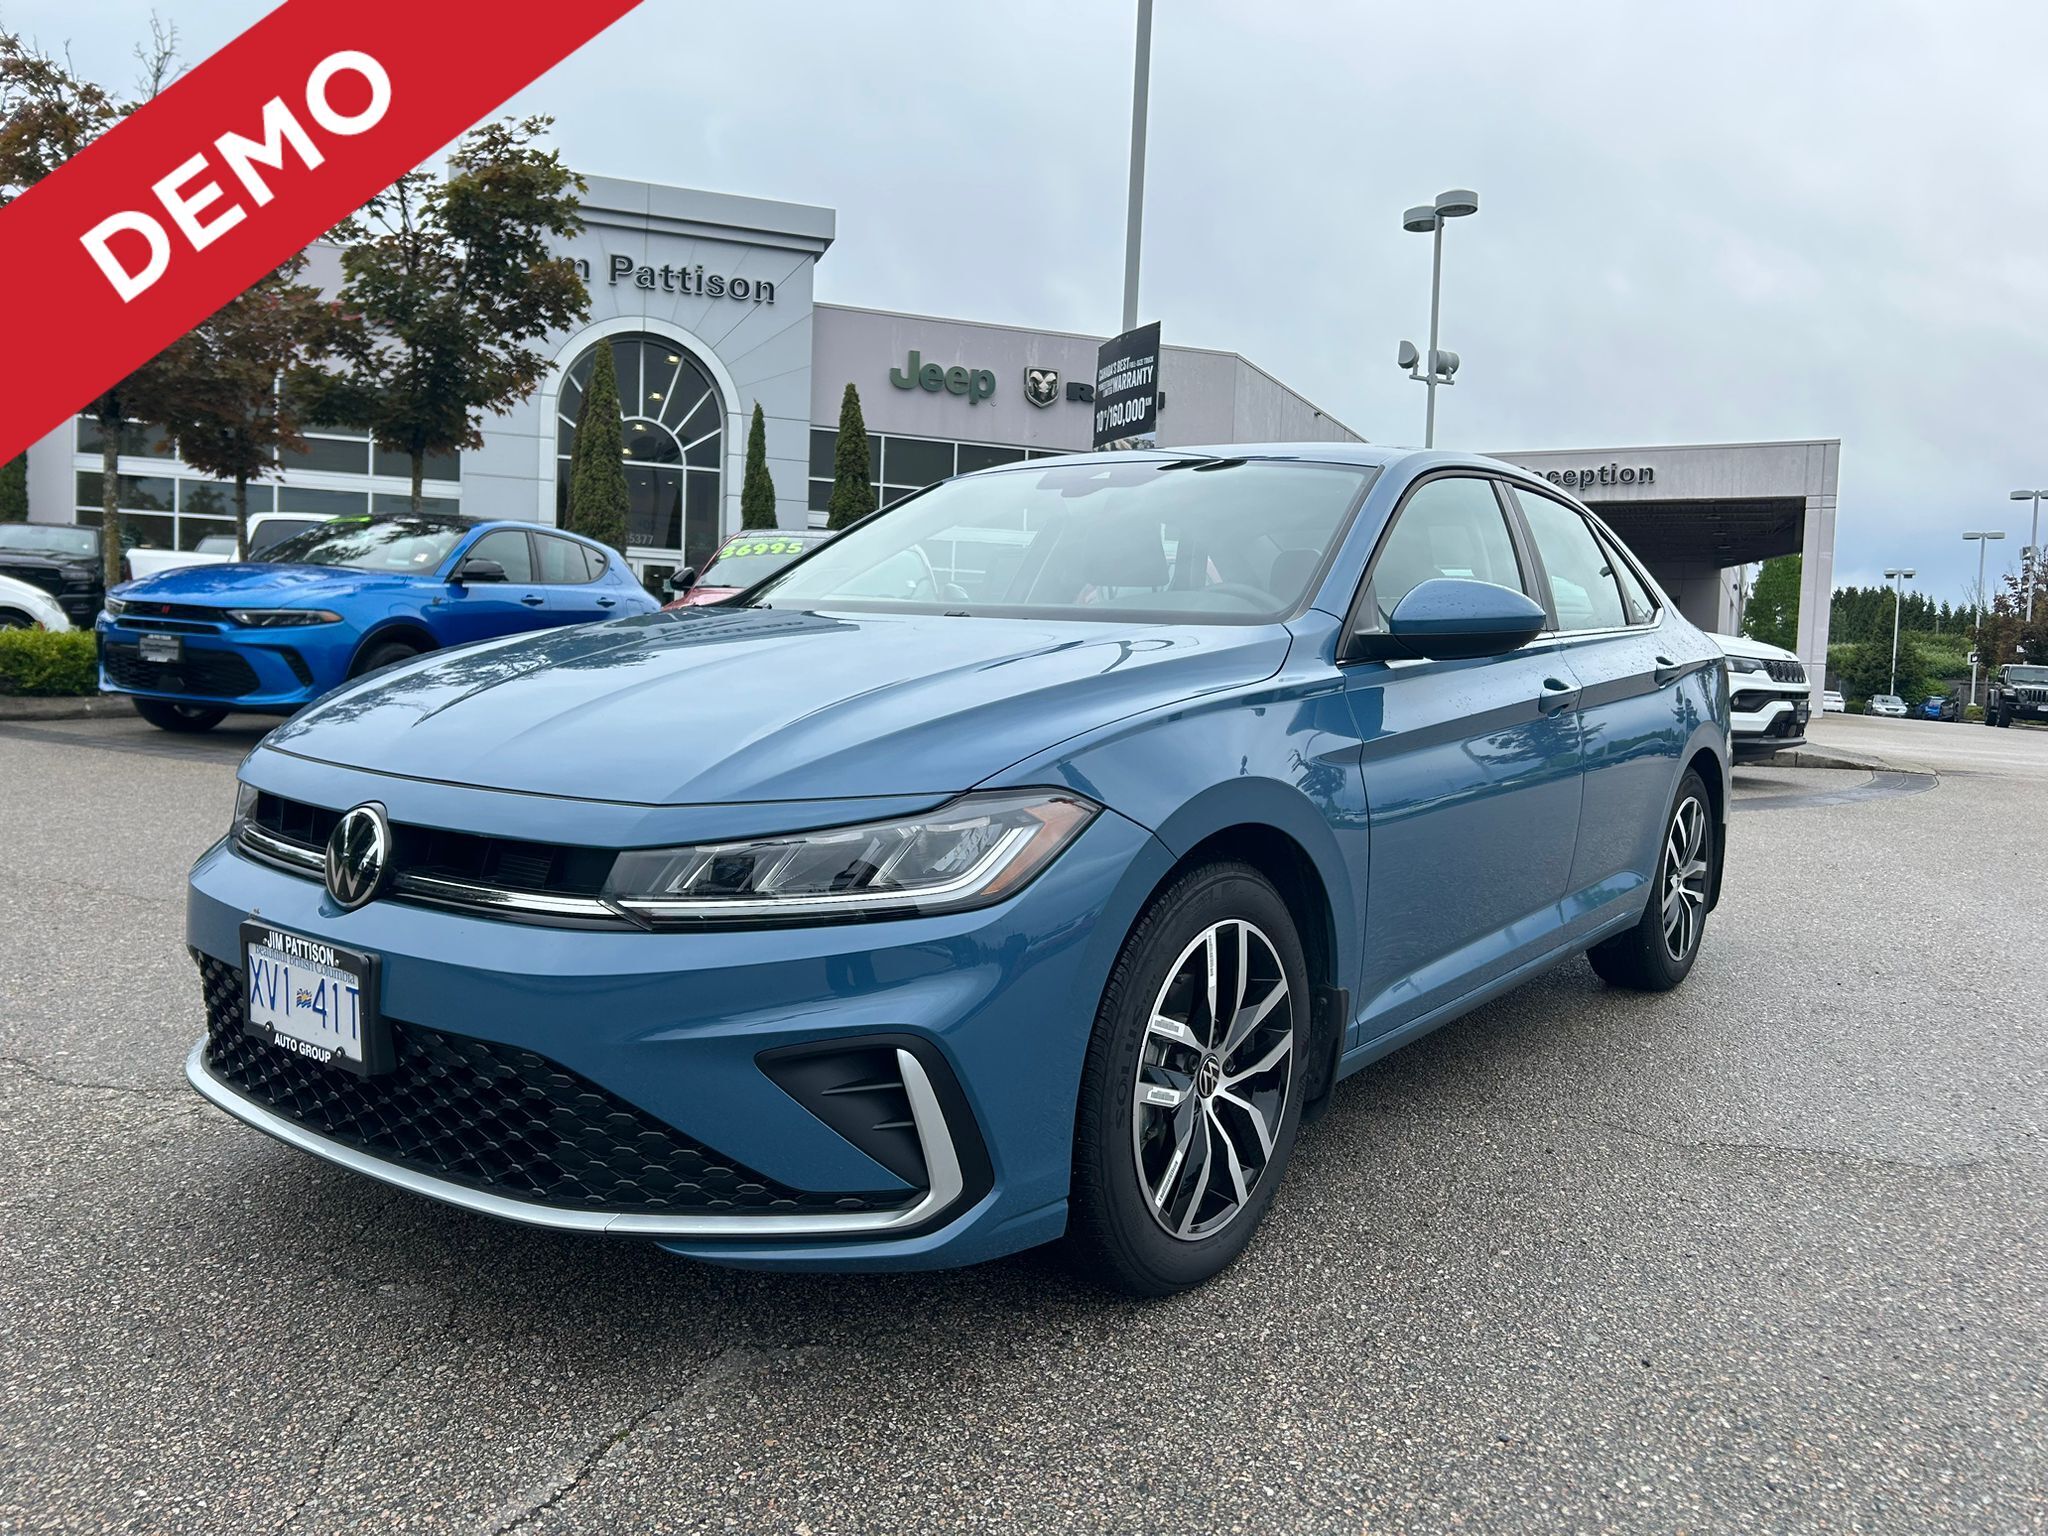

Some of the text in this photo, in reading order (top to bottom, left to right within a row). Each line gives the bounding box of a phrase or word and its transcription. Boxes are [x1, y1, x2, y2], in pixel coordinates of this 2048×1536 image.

[608, 253, 776, 304] Pattison
[889, 350, 997, 405] Jeep
[1112, 365, 1154, 393] WARRANTY
[1520, 463, 1656, 491] ception
[626, 533, 654, 545] 5377
[719, 542, 803, 560] 36995
[267, 931, 334, 967] JIM PATTISON
[315, 961, 356, 985] Columbia
[274, 1033, 331, 1063] AUTO GROUP
